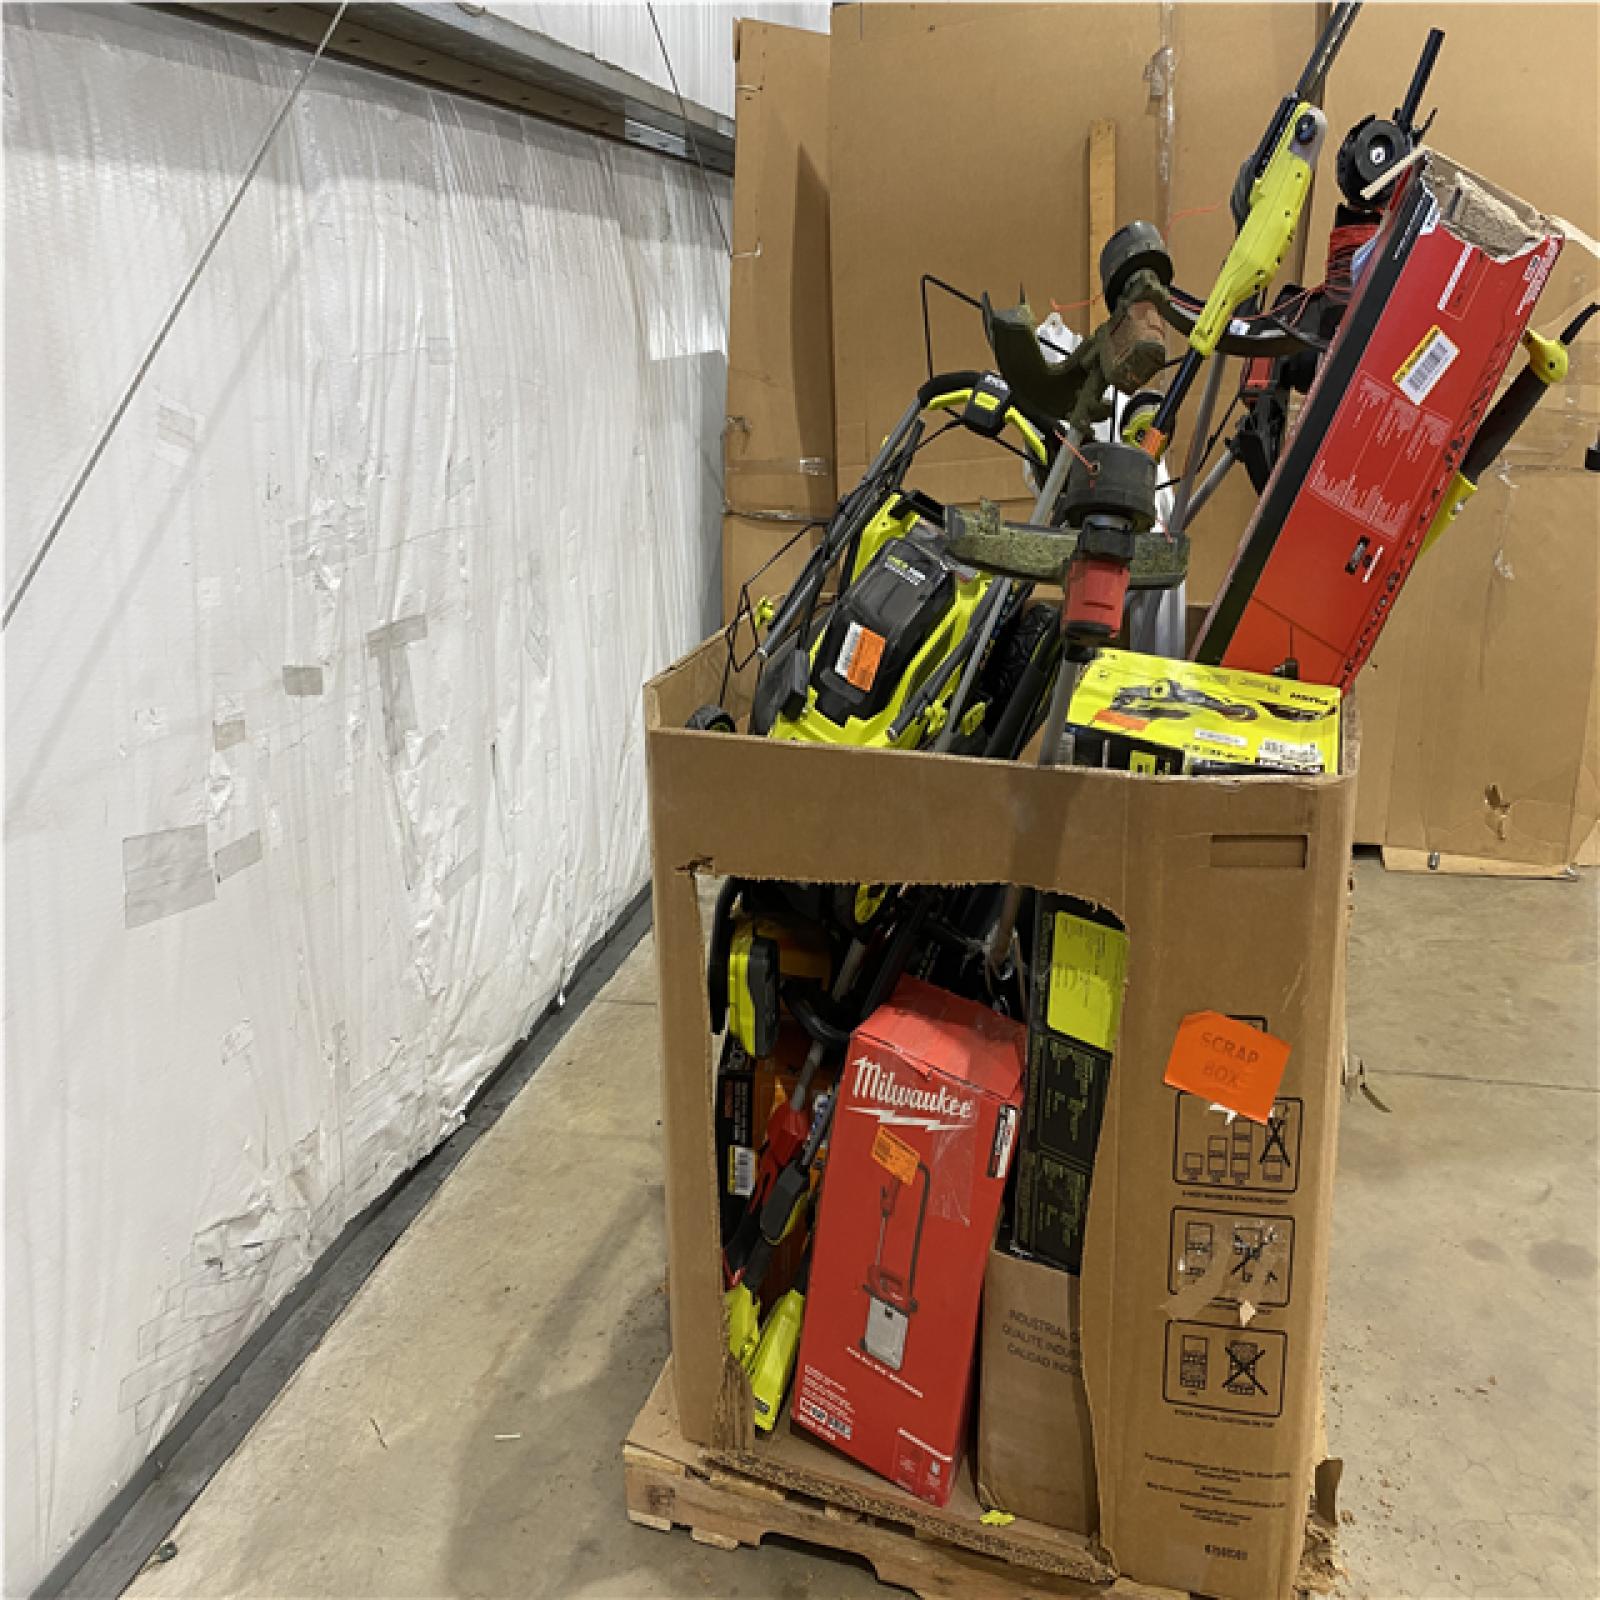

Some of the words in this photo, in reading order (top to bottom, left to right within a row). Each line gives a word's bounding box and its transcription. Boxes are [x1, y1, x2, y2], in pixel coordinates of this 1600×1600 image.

[1200, 1031, 1260, 1064] SCRAP
[850, 1056, 972, 1118] Milwaukee
[1201, 1060, 1240, 1088] BOX
